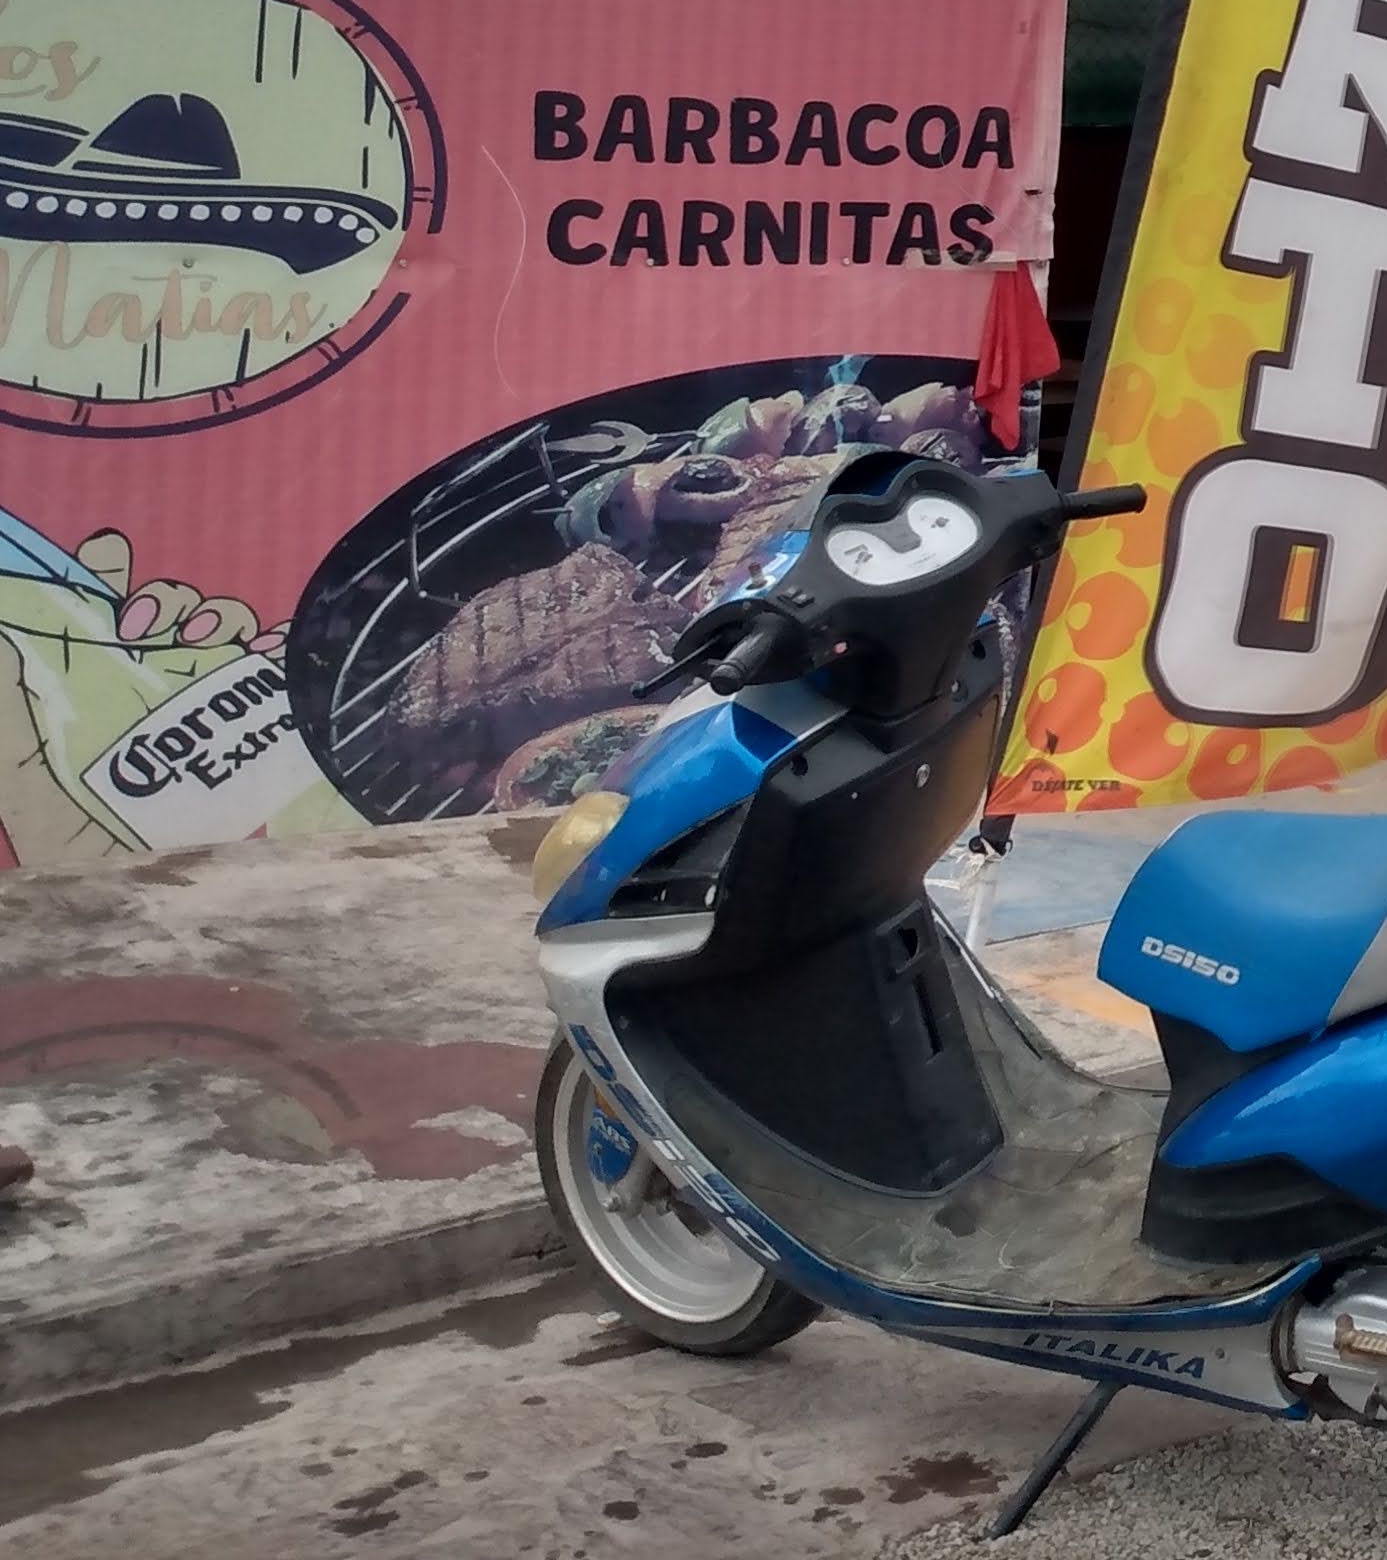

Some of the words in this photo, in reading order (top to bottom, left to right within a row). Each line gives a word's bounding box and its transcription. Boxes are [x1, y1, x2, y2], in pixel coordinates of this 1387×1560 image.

[534, 90, 1014, 170] BARBACOA
[547, 198, 995, 267] CARNITAS
[186, 713, 298, 790] Extra
[1023, 1332, 1206, 1379] ITALIKA
